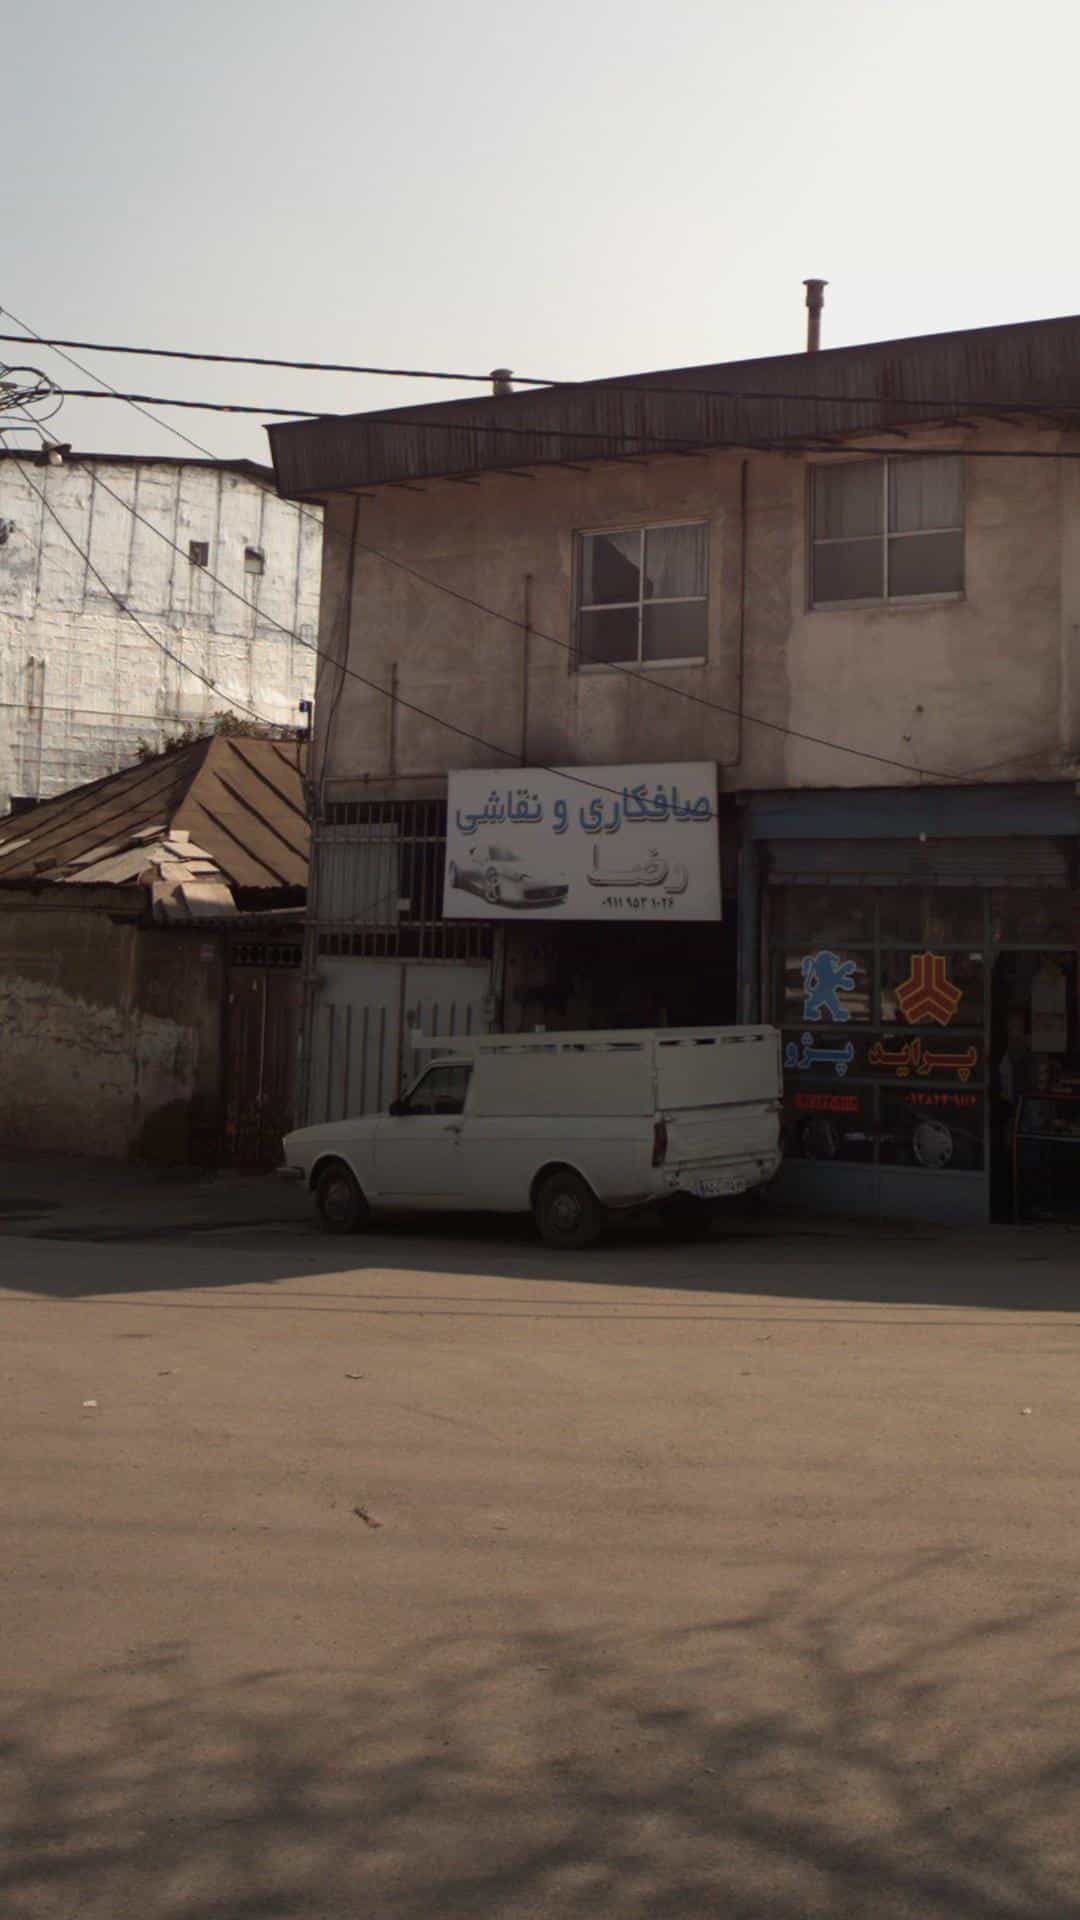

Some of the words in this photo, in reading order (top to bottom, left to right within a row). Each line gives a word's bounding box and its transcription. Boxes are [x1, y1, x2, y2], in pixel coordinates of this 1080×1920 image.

[455, 789, 544, 835] نقاشی
[551, 799, 570, 834] و
[784, 1032, 855, 1077] پژو
[868, 1037, 978, 1083] پراید
